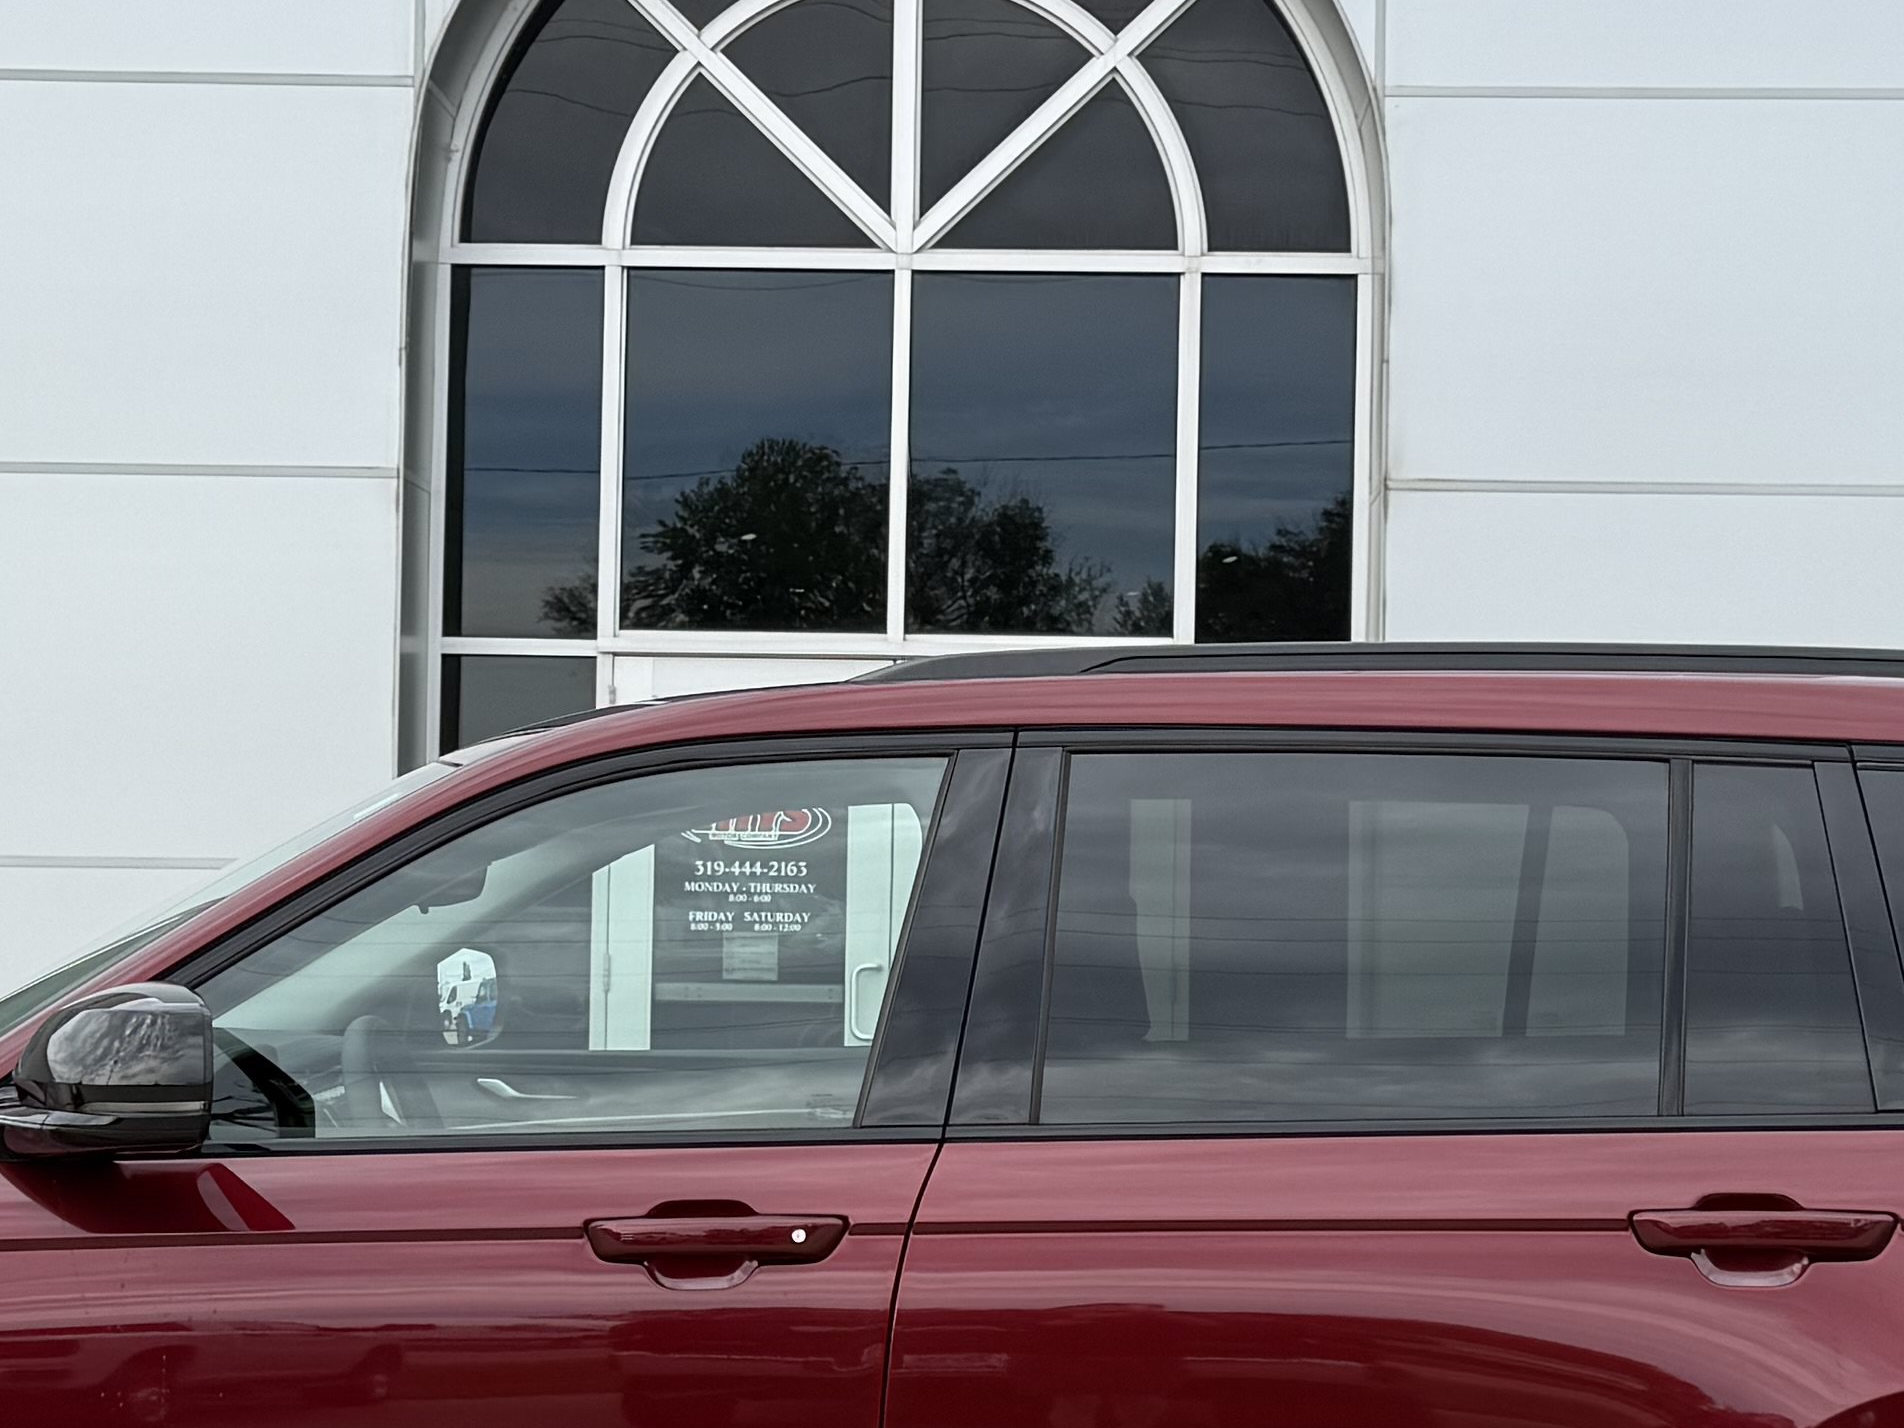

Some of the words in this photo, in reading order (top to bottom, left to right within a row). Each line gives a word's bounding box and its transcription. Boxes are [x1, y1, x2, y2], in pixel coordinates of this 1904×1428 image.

[694, 860, 808, 877] 319-444-2163
[684, 881, 740, 893] MONDAY
[748, 882, 816, 894] THURSDAY
[688, 911, 735, 922] FRIDAY
[743, 912, 811, 923] SATURDAY
